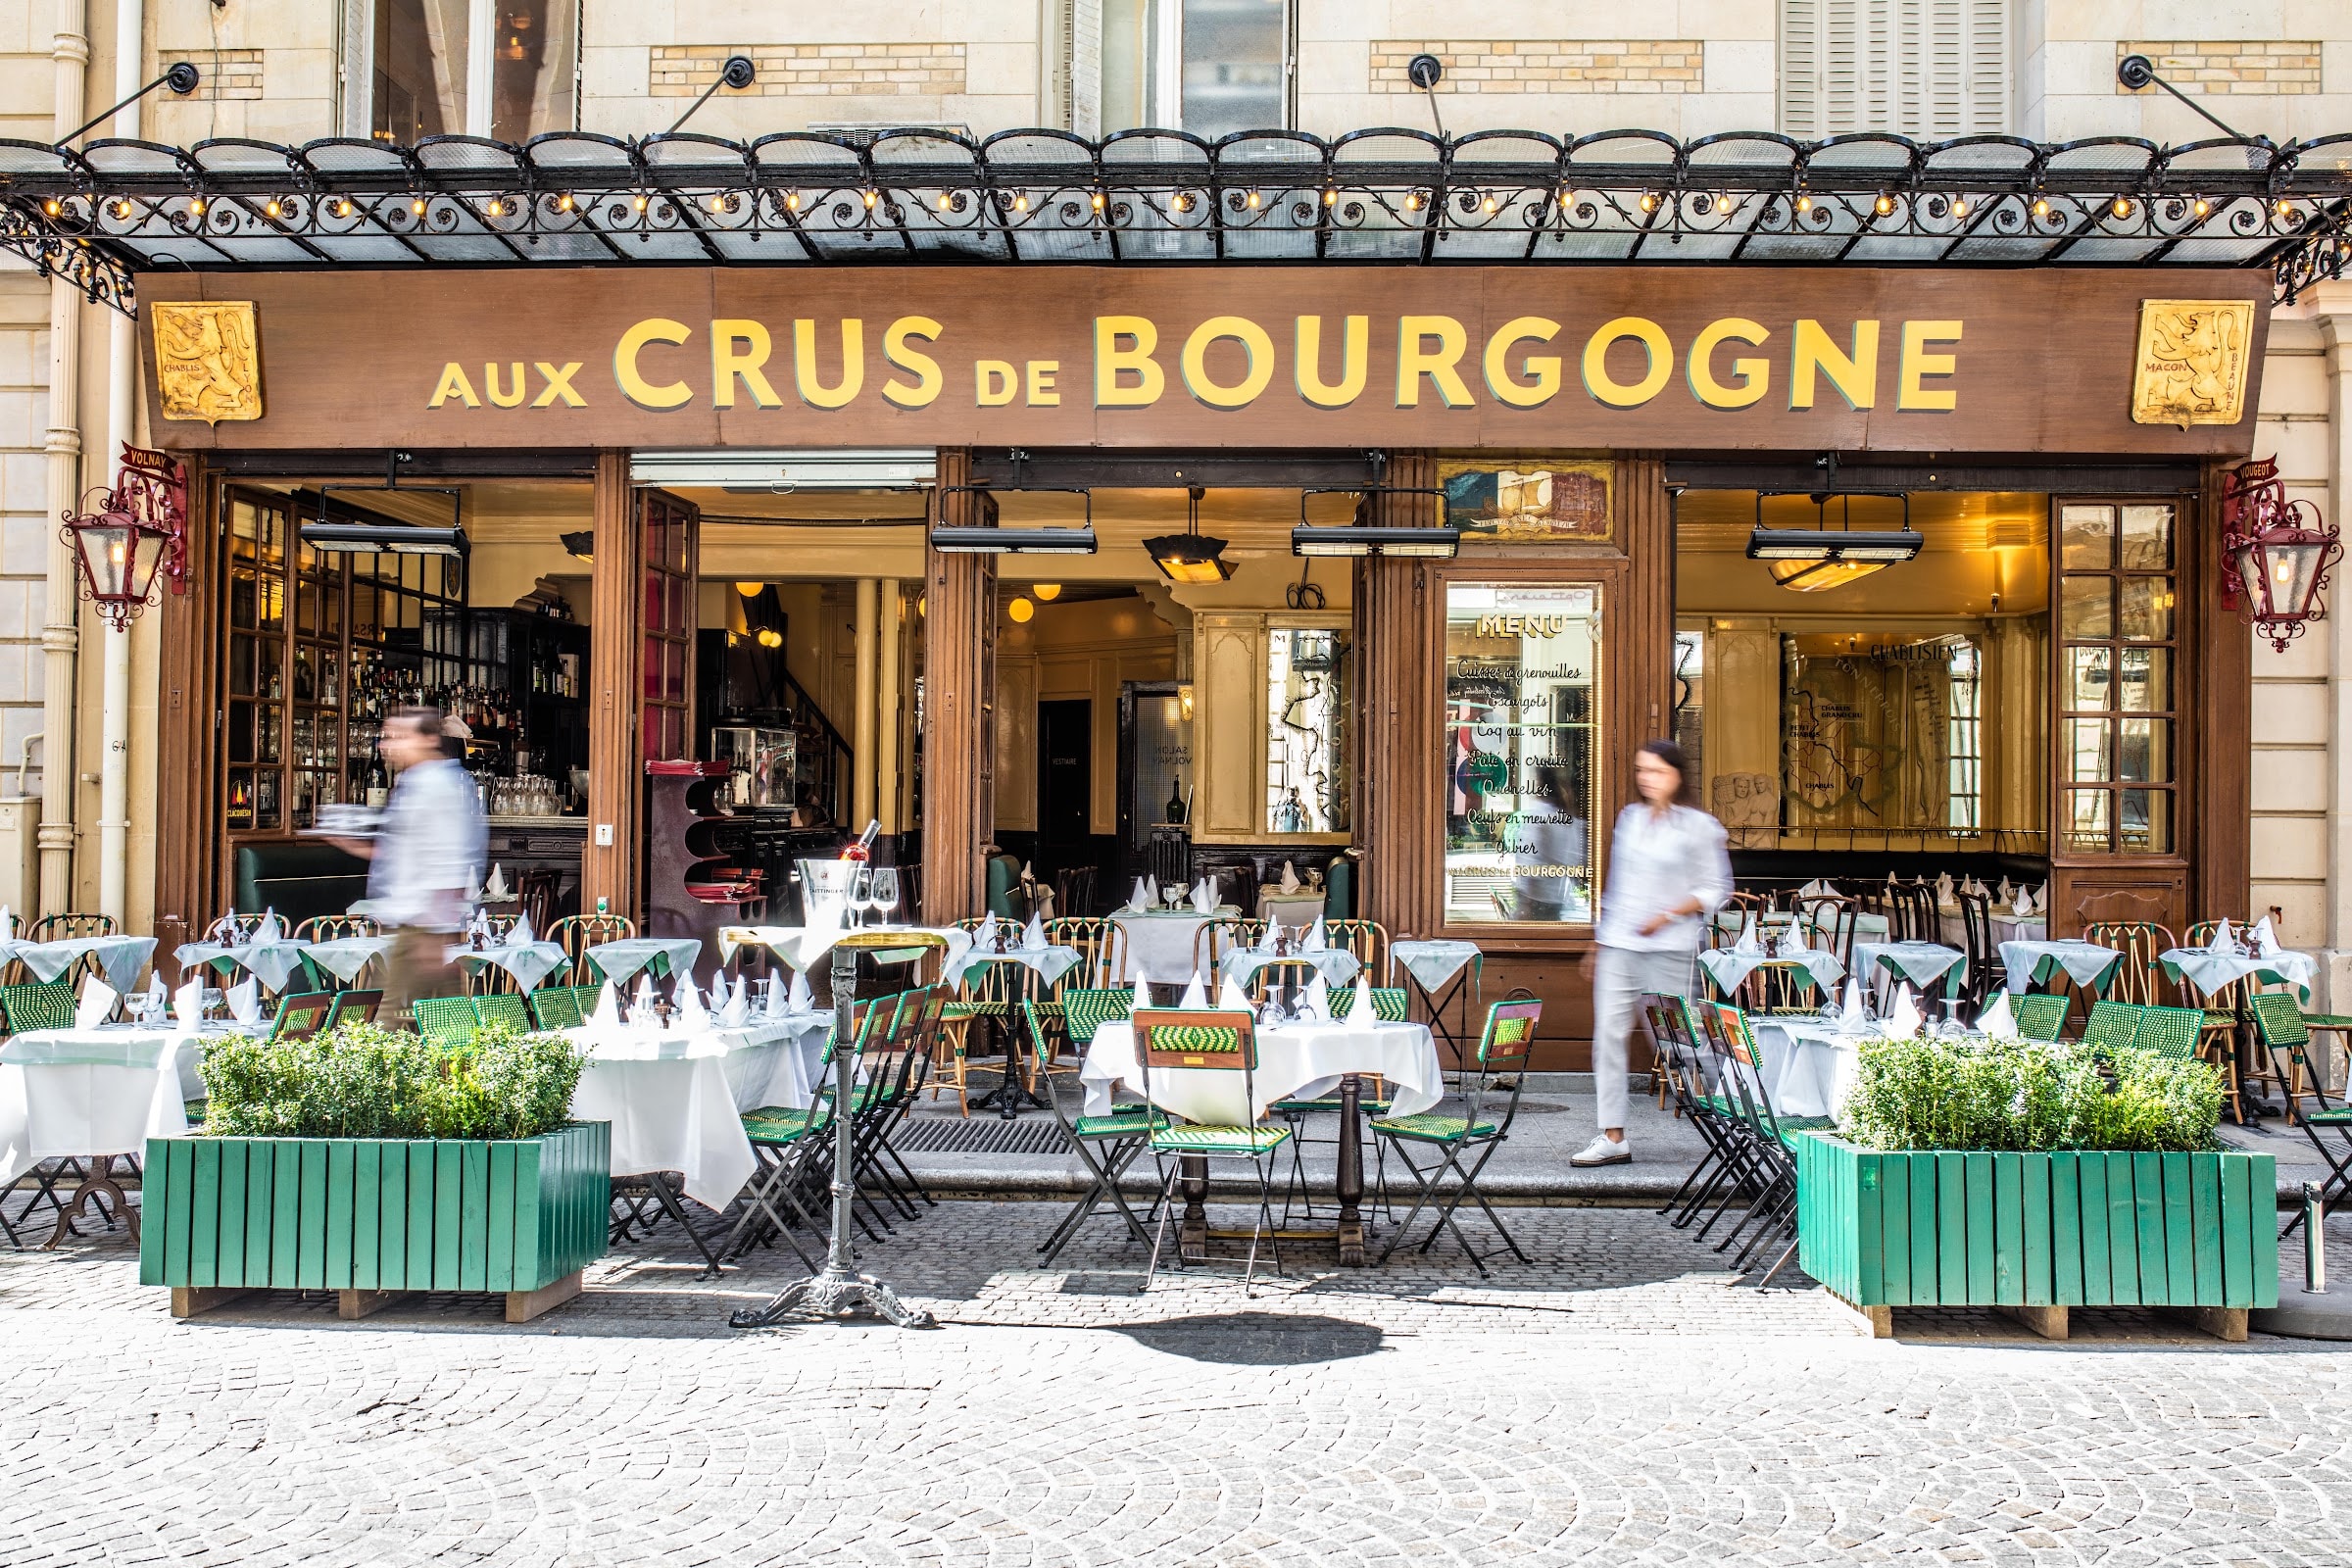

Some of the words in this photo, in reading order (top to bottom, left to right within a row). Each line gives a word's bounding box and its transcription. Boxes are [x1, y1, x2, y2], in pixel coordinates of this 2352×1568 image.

[164, 364, 200, 372] CHABLIS
[426, 362, 588, 410] AUX
[612, 316, 944, 414] CRUS
[975, 361, 1060, 408] DE
[1094, 315, 1963, 413] BOURGOGNE
[2144, 363, 2187, 372] MACON
[242, 363, 253, 404] LYON
[2226, 352, 2238, 411] BEAUNE
[130, 450, 167, 468] VOLNAY
[2240, 463, 2271, 479] VOUGEOT
[1476, 613, 1568, 639] MENU
[1870, 644, 1957, 662] CHABLISIEN
[1457, 659, 1502, 679] Cuisses
[1516, 663, 1582, 686] grenouilles
[1477, 720, 1502, 743] Coq
[1506, 726, 1524, 737] au
[1529, 723, 1558, 737] vin
[1504, 755, 1520, 767] en
[1483, 779, 1553, 797] Quenelles
[1504, 812, 1520, 824] en
[1521, 809, 1574, 826] meurette
